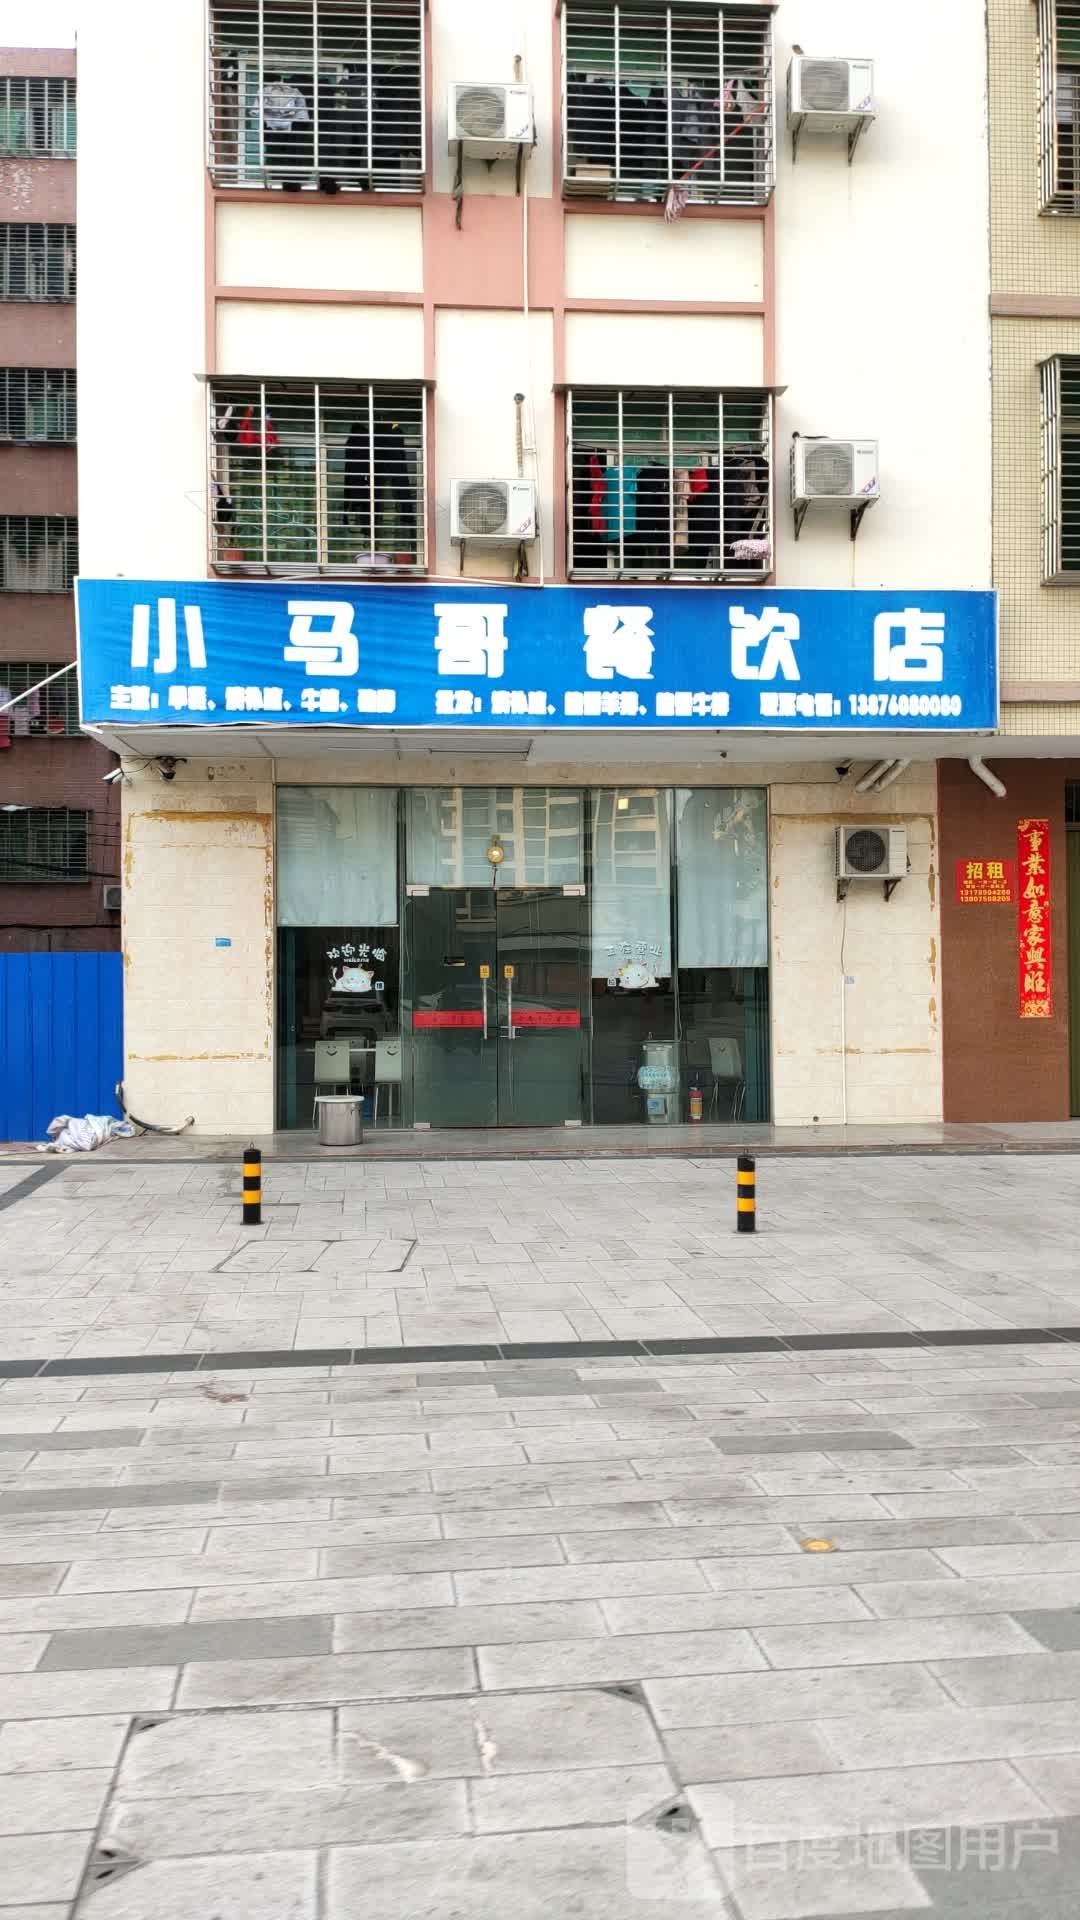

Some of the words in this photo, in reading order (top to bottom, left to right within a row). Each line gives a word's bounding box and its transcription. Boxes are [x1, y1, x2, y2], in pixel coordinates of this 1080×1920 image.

[131, 598, 946, 682] 小马哥餐饮店
[966, 861, 1004, 879] 招租
[326, 943, 388, 962] 欢迎光临
